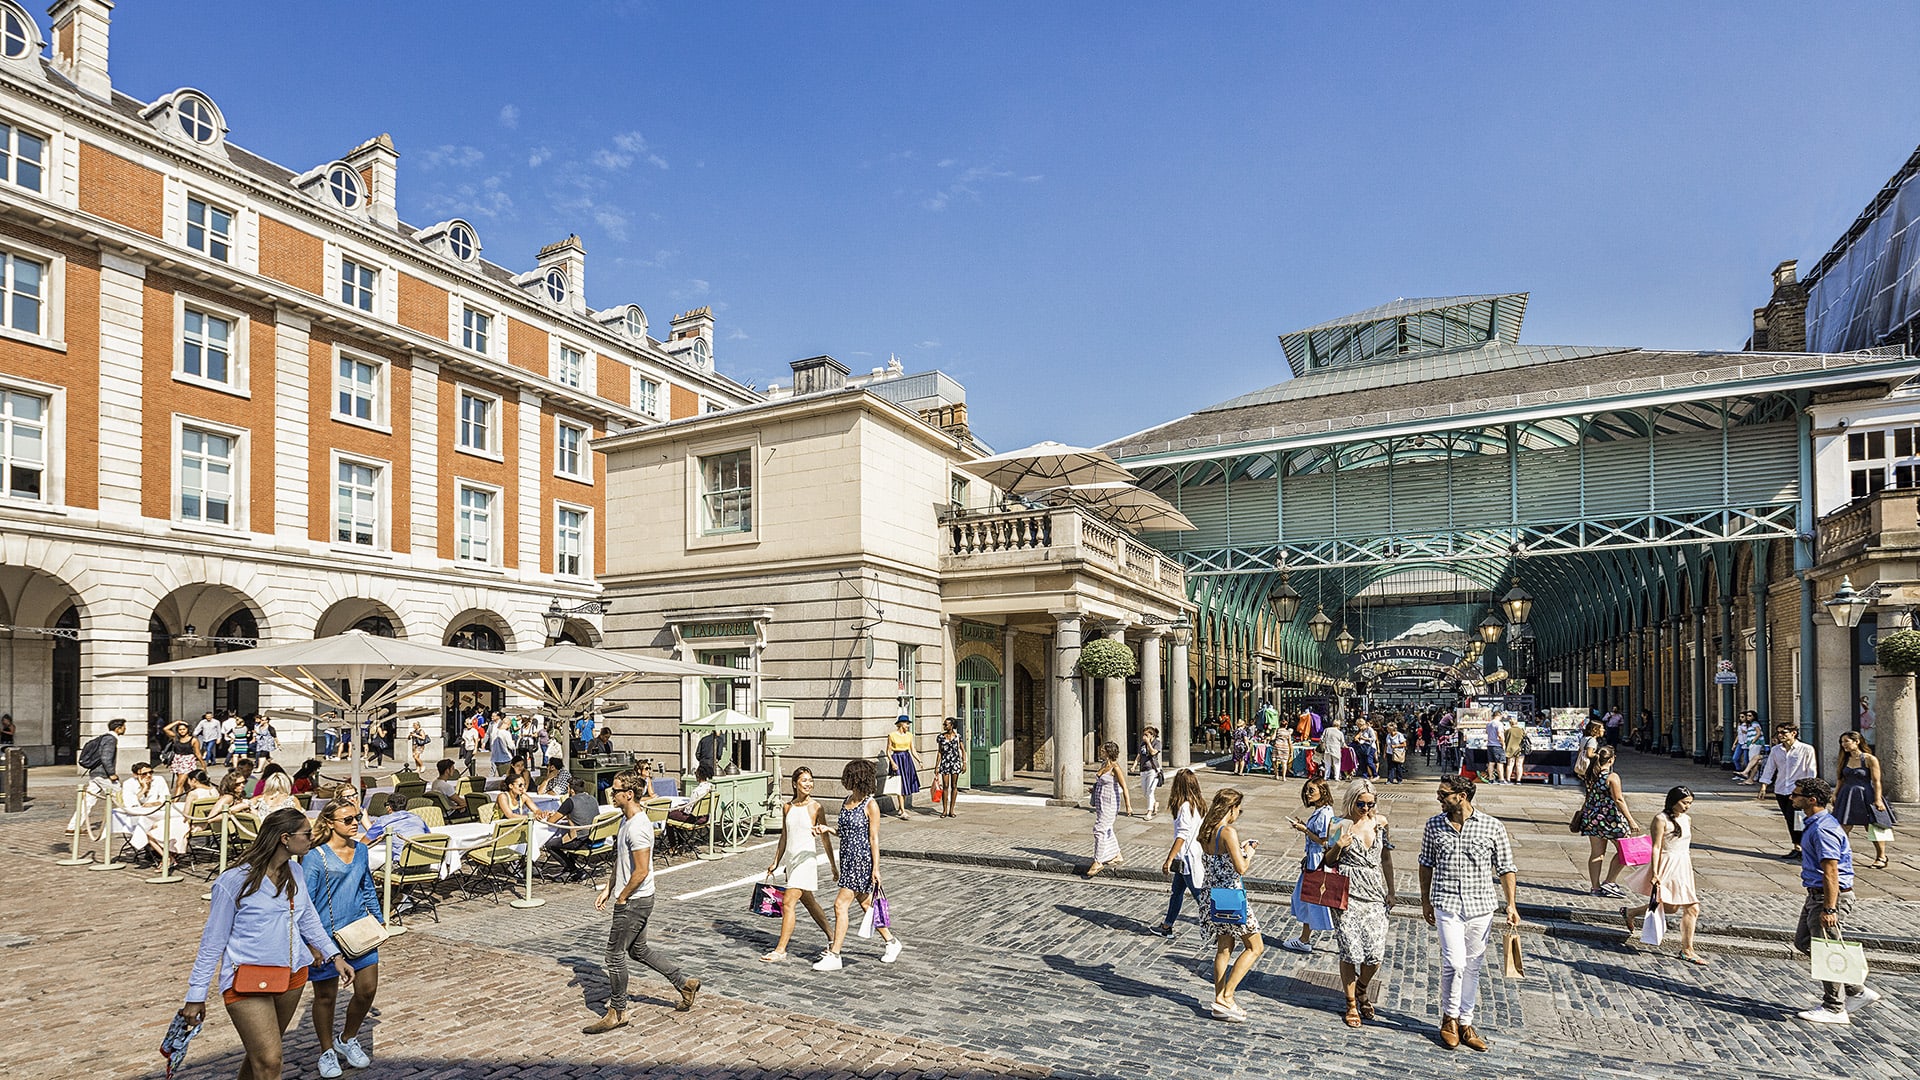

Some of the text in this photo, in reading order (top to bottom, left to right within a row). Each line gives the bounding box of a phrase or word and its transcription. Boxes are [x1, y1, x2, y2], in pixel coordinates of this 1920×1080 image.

[1360, 648, 1443, 662] APPLE MARKET
[1387, 669, 1441, 678] APPLE MARKET
